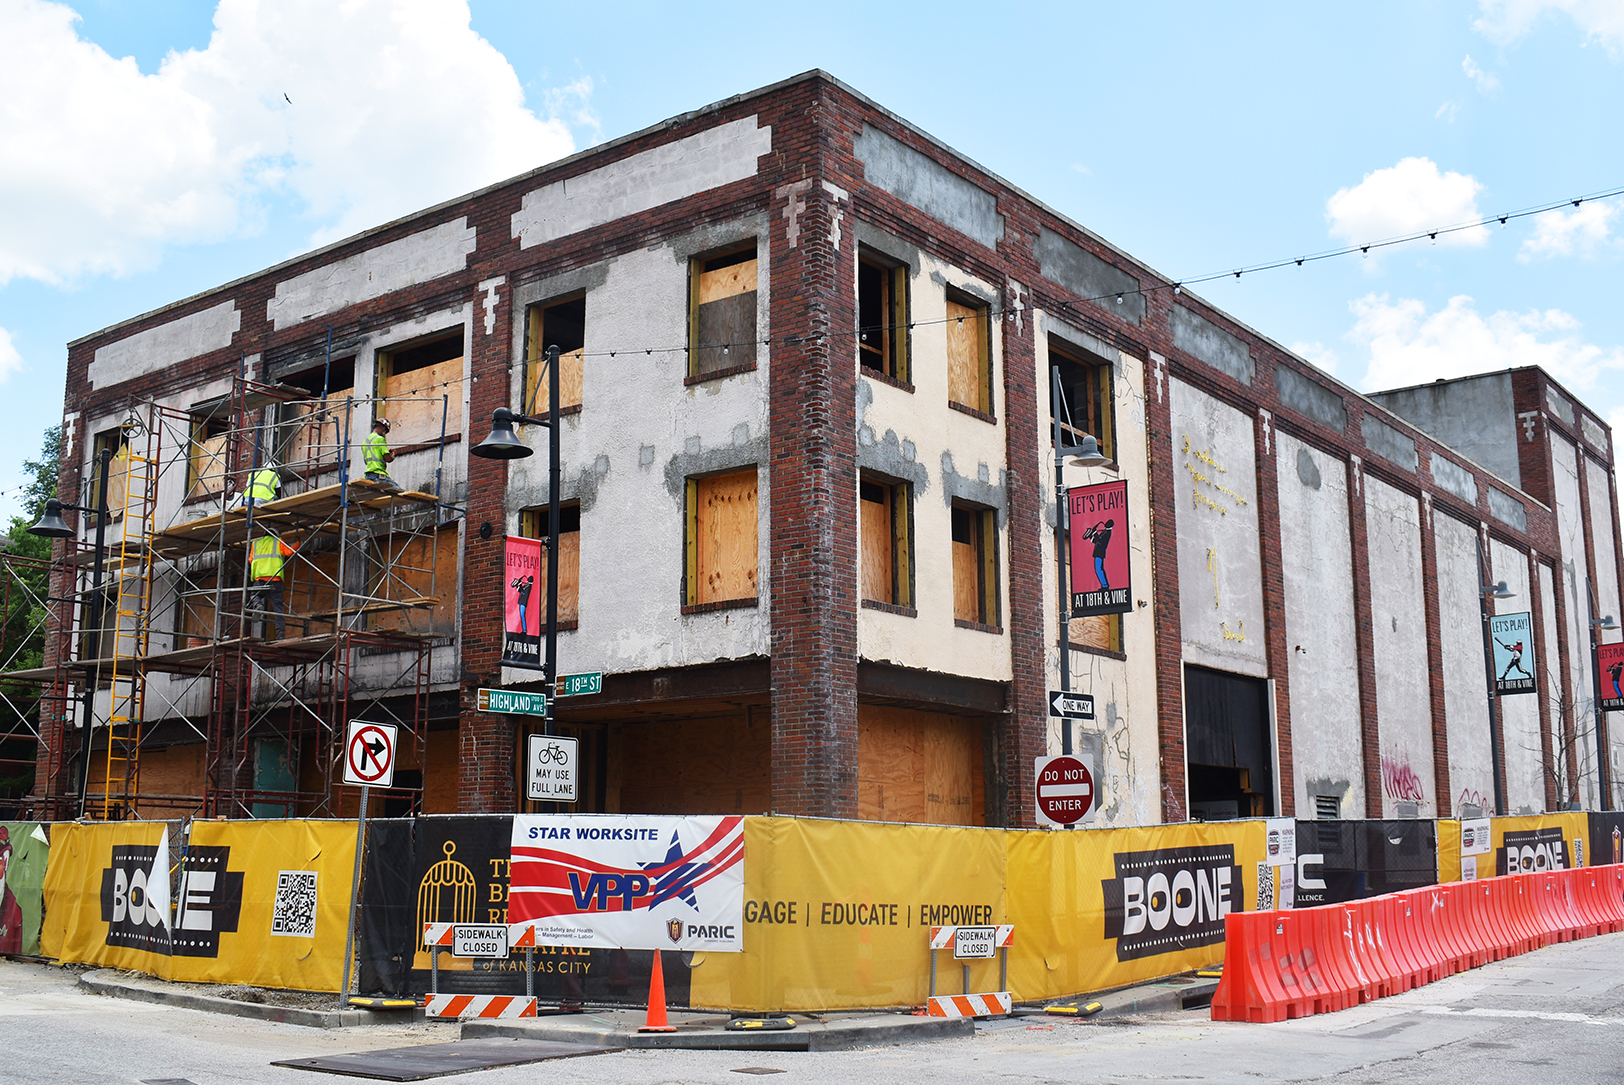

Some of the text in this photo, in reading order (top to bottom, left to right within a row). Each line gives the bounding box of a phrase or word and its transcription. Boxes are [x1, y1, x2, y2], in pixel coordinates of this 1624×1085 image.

[1071, 490, 1124, 515] LET'S PLAY!
[506, 551, 539, 571] LET'S PLAY!
[1075, 589, 1127, 608] AT 18TH & VINE
[1491, 618, 1528, 633] LET'S PLAY!
[589, 675, 601, 691] ST
[489, 692, 531, 712] HIGHLAND
[533, 704, 544, 713] AVE
[1062, 699, 1090, 713] ONE WAY
[536, 768, 570, 780] MAY USE
[1044, 768, 1085, 782] DO NOT
[531, 782, 573, 794] FULL LANE
[1049, 799, 1082, 812] ENTER
[528, 826, 659, 841] STAR WORKSITE
[1507, 841, 1564, 875] BOONE
[567, 871, 651, 912] VPP
[1123, 866, 1232, 936] BOONE
[821, 903, 898, 926] EDUCATE
[920, 904, 993, 926] EMPOWER
[458, 929, 503, 939] SIDEWALK
[687, 925, 735, 939] PARIC
[959, 931, 992, 941] SIDEWALK
[463, 942, 498, 952] CLOSED
[962, 944, 989, 953] CLOSED
[482, 960, 495, 973] of
[558, 961, 591, 974] CITY
